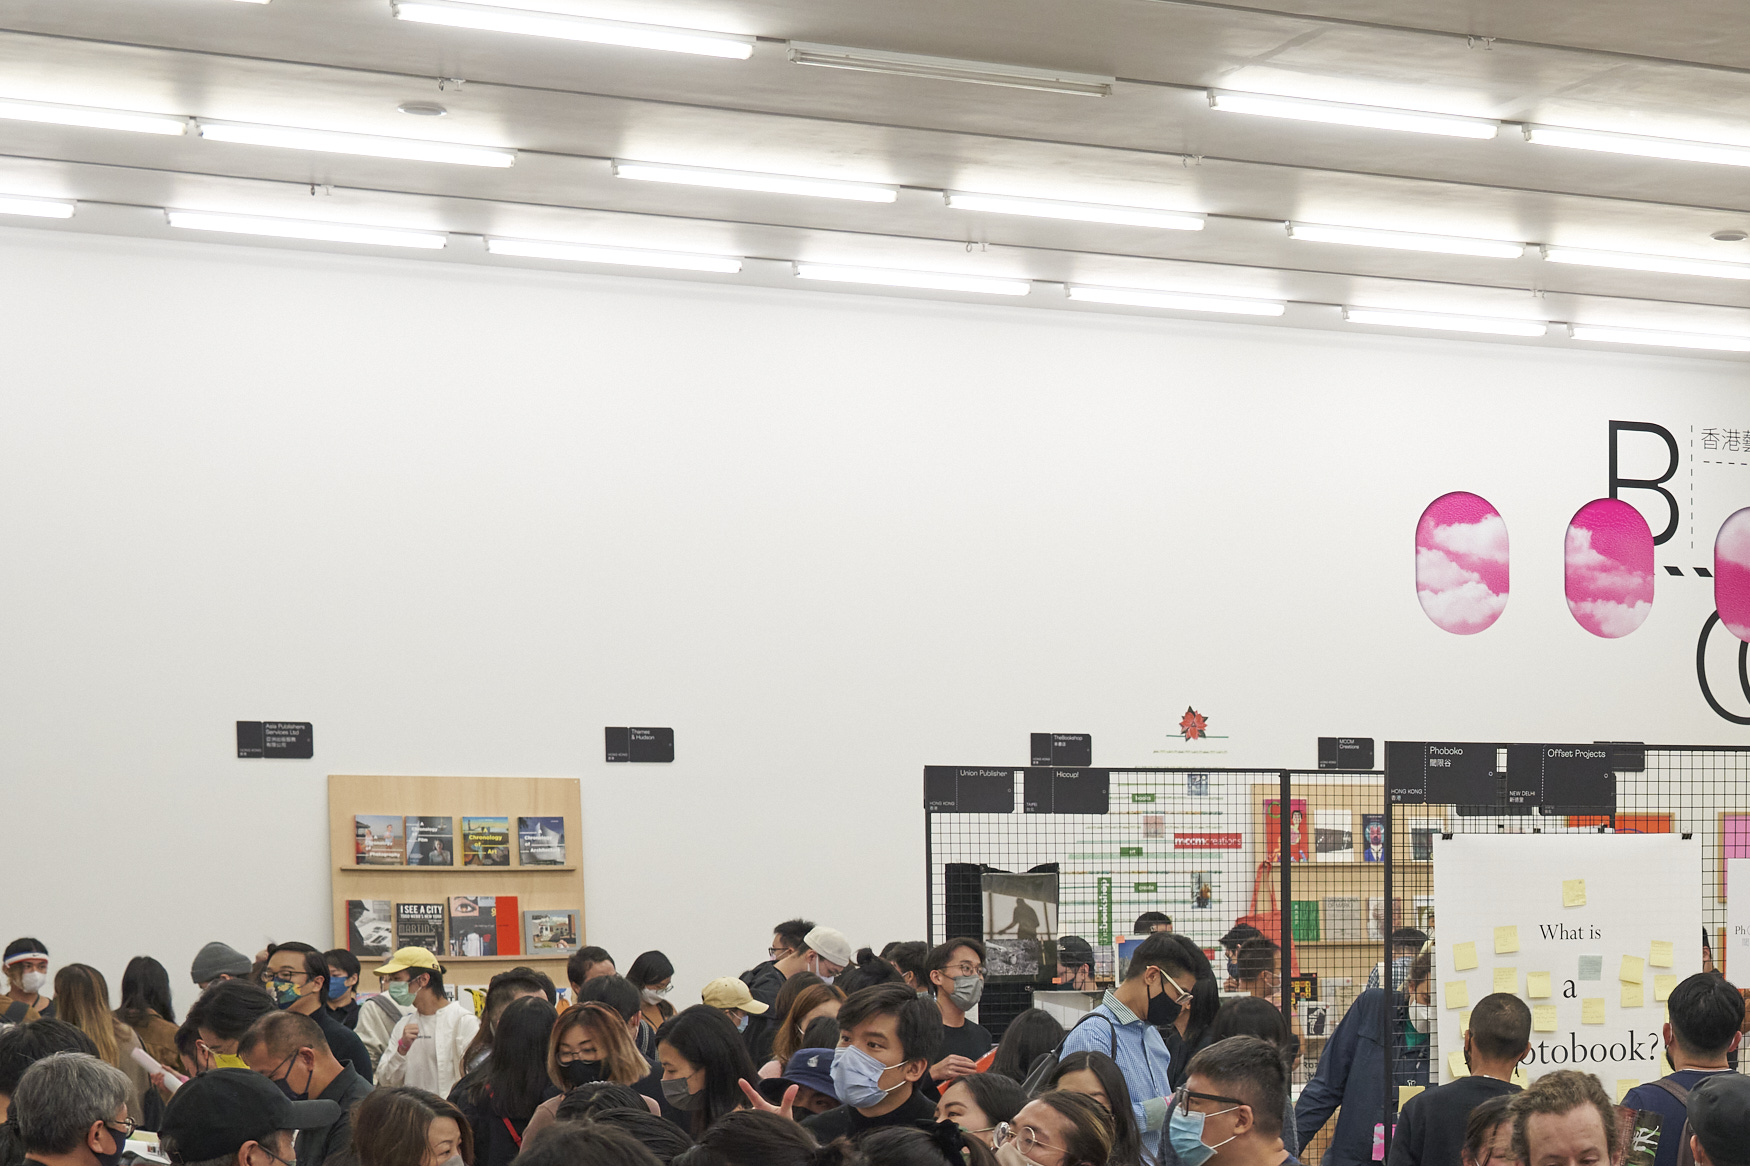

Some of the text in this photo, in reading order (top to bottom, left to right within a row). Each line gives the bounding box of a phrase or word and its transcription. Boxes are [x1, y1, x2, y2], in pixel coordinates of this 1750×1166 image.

[1429, 746, 1463, 756] Phoboko
[1548, 749, 1606, 759] Offset Projects
[1174, 836, 1242, 845] mccmcreations
[404, 905, 418, 913] SEE
[420, 905, 426, 913] A
[426, 905, 442, 913] CITY
[1539, 923, 1584, 940] What
[1590, 924, 1601, 940] is
[1735, 926, 1746, 935] Ph
[1563, 980, 1577, 999] a
[1519, 1030, 1659, 1065] otobook?
